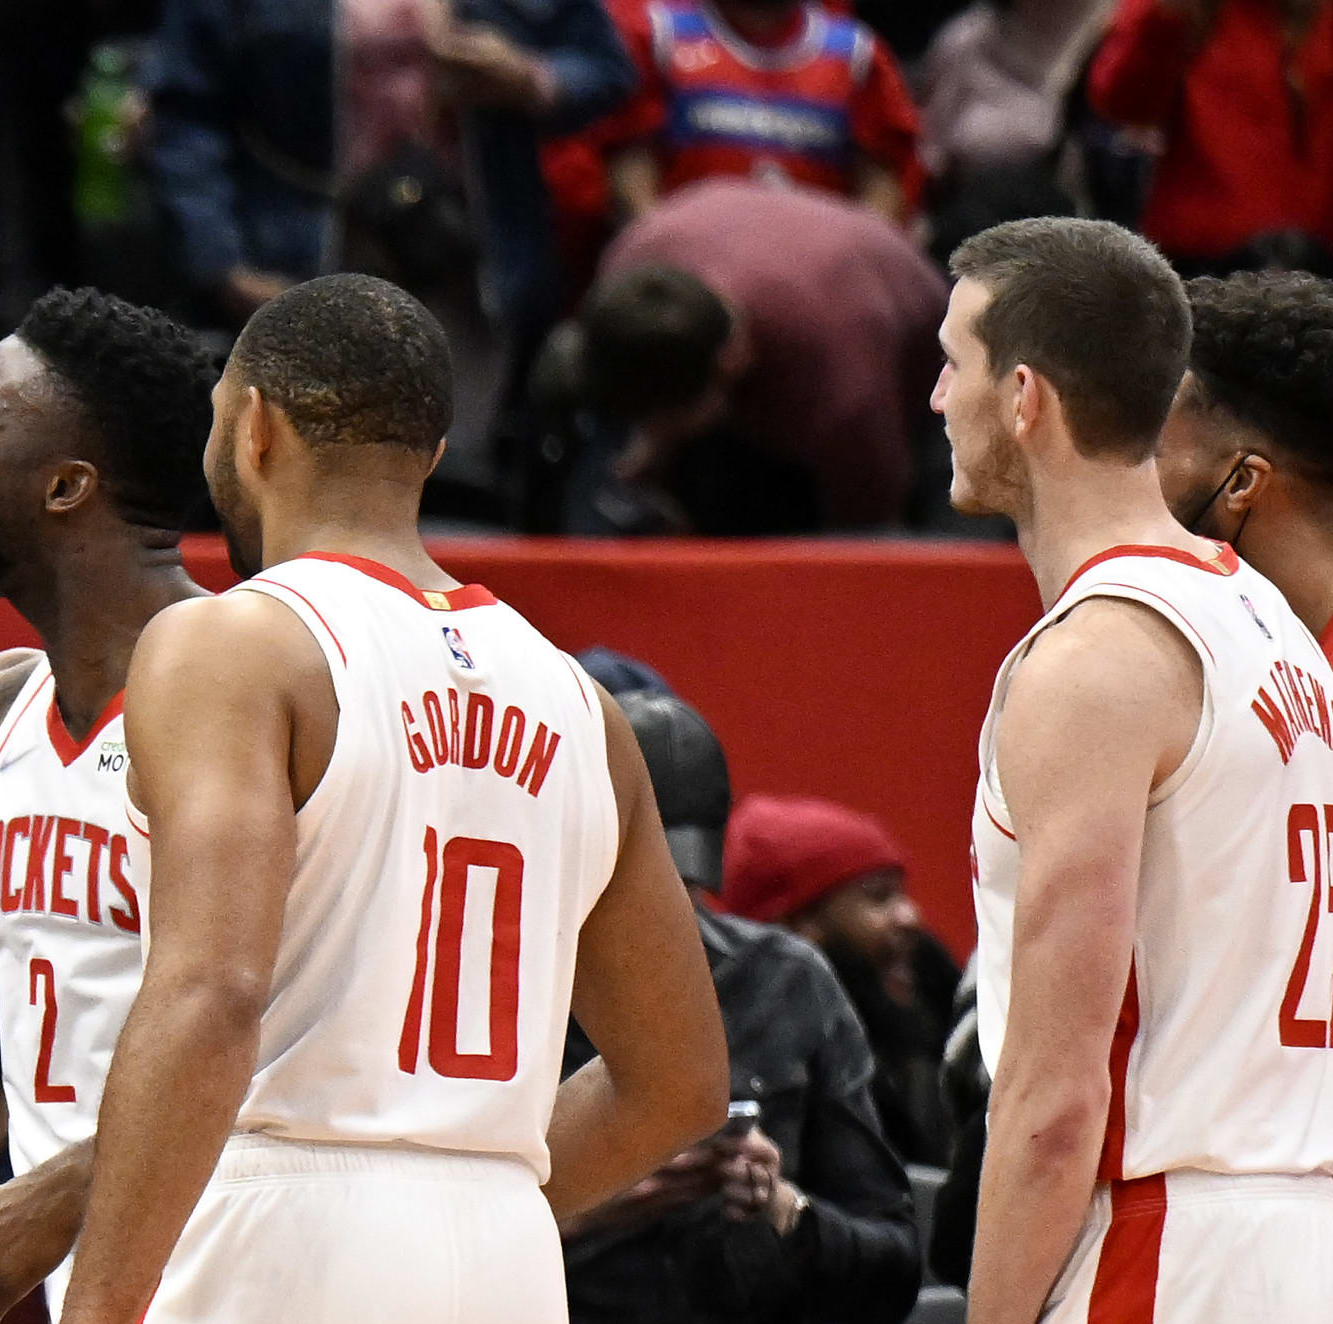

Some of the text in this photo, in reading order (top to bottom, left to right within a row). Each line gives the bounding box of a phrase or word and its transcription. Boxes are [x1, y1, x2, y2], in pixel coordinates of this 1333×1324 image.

[401, 688, 562, 798] GORDON
[398, 826, 525, 1082] 10
[1279, 804, 1333, 1048] 2
[28, 958, 77, 1103] 2
